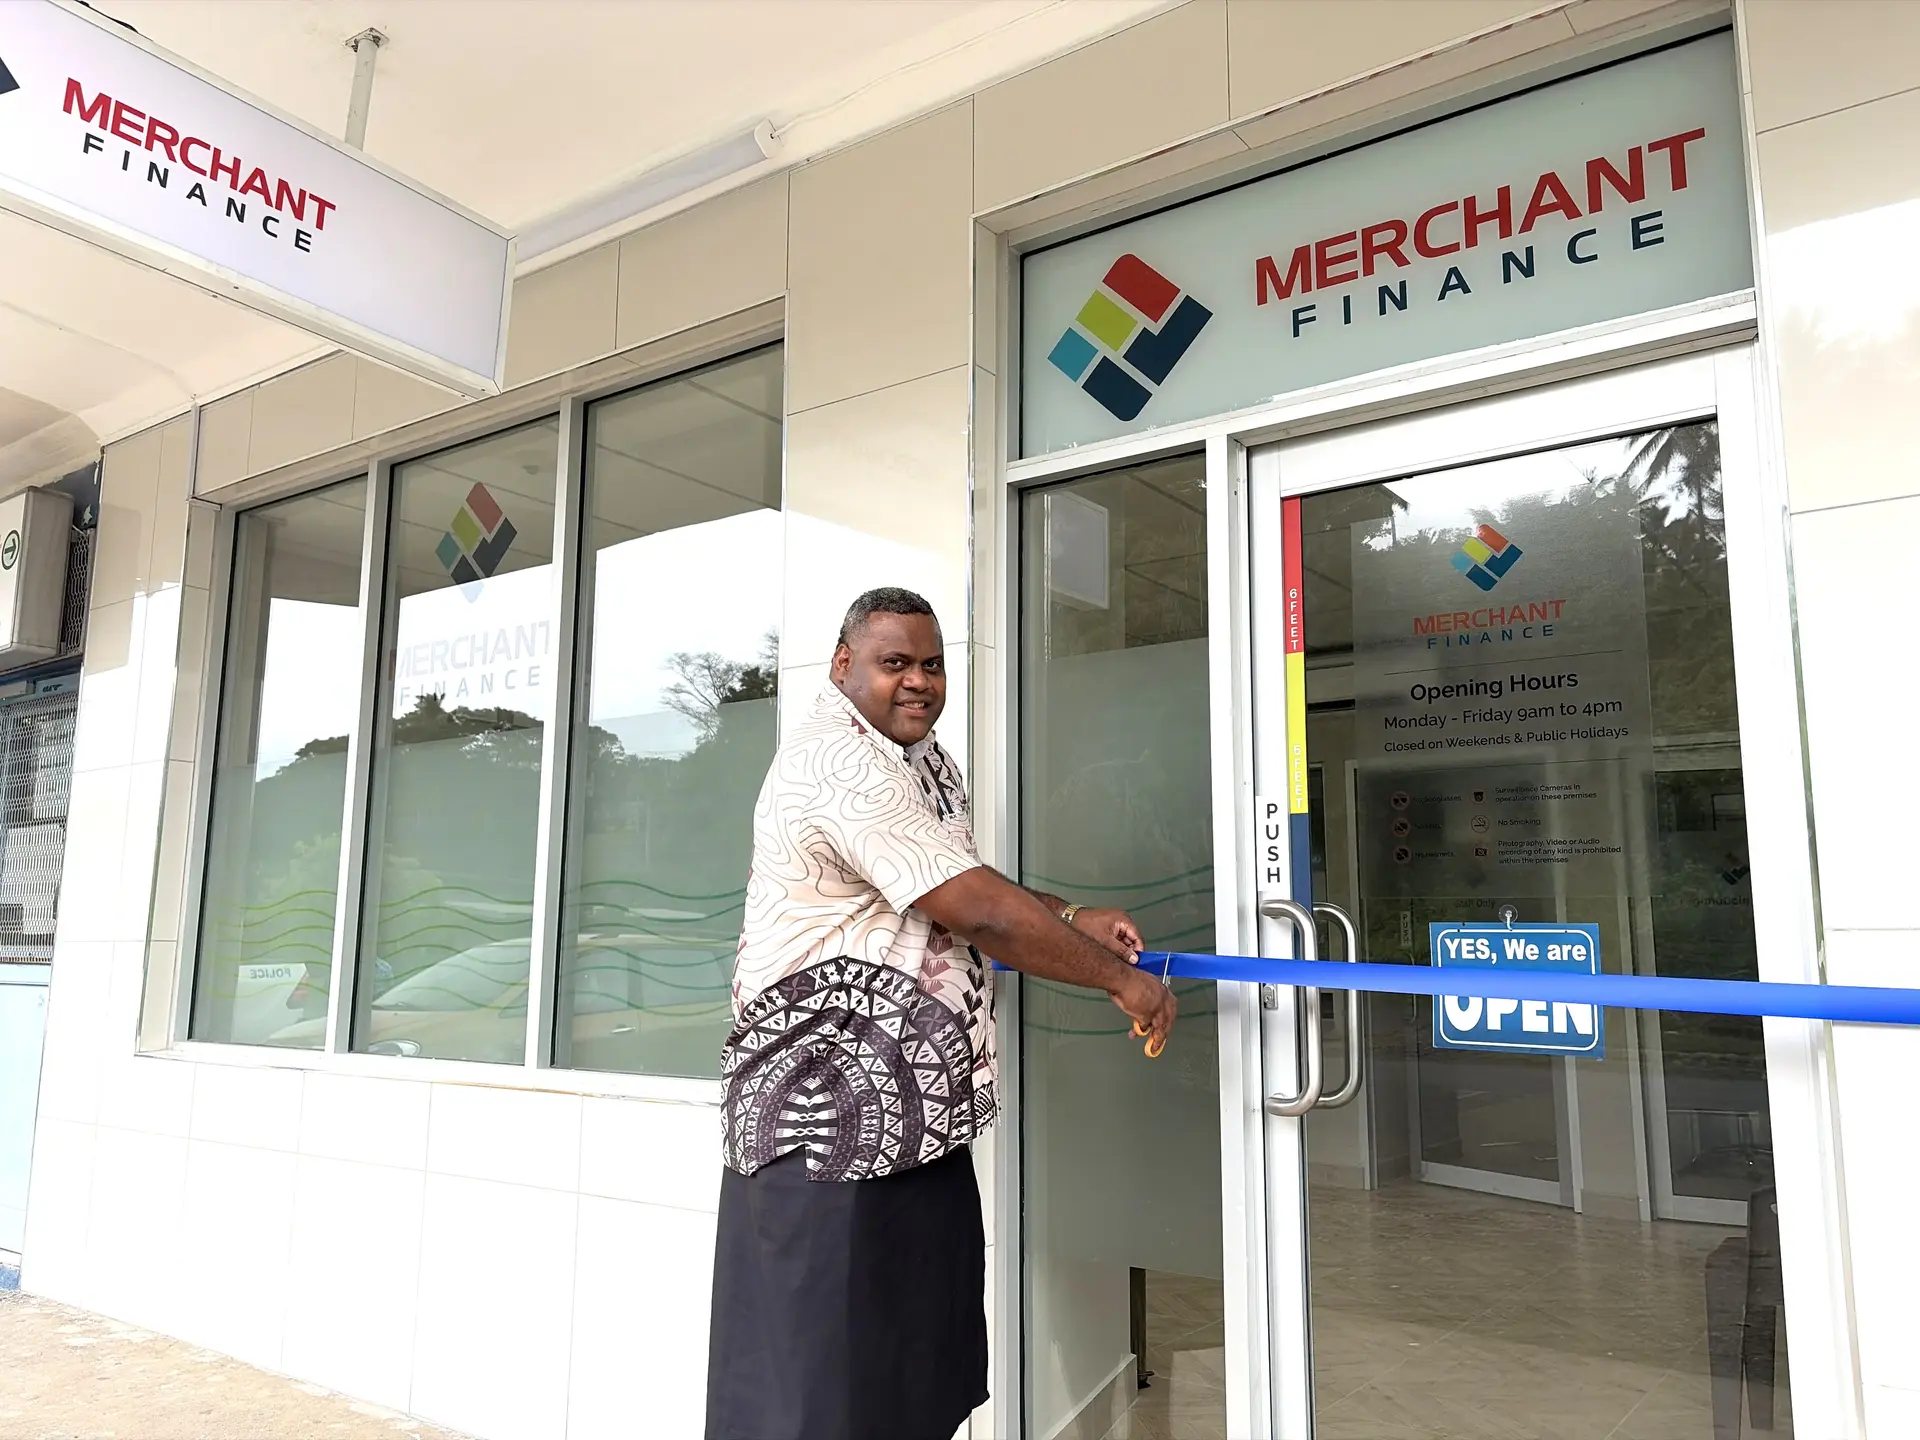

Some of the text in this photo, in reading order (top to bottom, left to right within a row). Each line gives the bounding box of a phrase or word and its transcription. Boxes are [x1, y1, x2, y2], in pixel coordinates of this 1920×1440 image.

[62, 77, 336, 231] MERCHANT
[83, 132, 312, 253] FINANCE
[1256, 127, 1705, 306] MERCHANT
[1292, 210, 1665, 338] FINANCE
[1412, 600, 1567, 636] MERCHANT
[388, 620, 549, 681] MERCHANT
[1427, 624, 1554, 650] FINANCE
[400, 665, 541, 706] FINANCE
[1410, 673, 1579, 704] Opening Hours
[1384, 714, 1447, 730] Monday
[1463, 708, 1513, 724] Friday
[1517, 705, 1554, 721] 9am
[1560, 702, 1577, 715] to
[1582, 701, 1622, 717] 4pm
[1384, 726, 1629, 752] Closed on Weekends & Public Holidays
[1540, 784, 1572, 792] Cameras
[1563, 792, 1597, 800] premises
[1509, 818, 1541, 826] Smoking
[1265, 803, 1281, 883] PUSH
[1498, 849, 1532, 857] recording
[1557, 846, 1573, 854] kind
[1582, 846, 1622, 855] prohibited
[1546, 838, 1567, 846] Video
[1578, 837, 1600, 845] Audio
[1535, 856, 1569, 864] premises
[1476, 899, 1496, 909] Only
[1444, 938, 1587, 965] YES, We are
